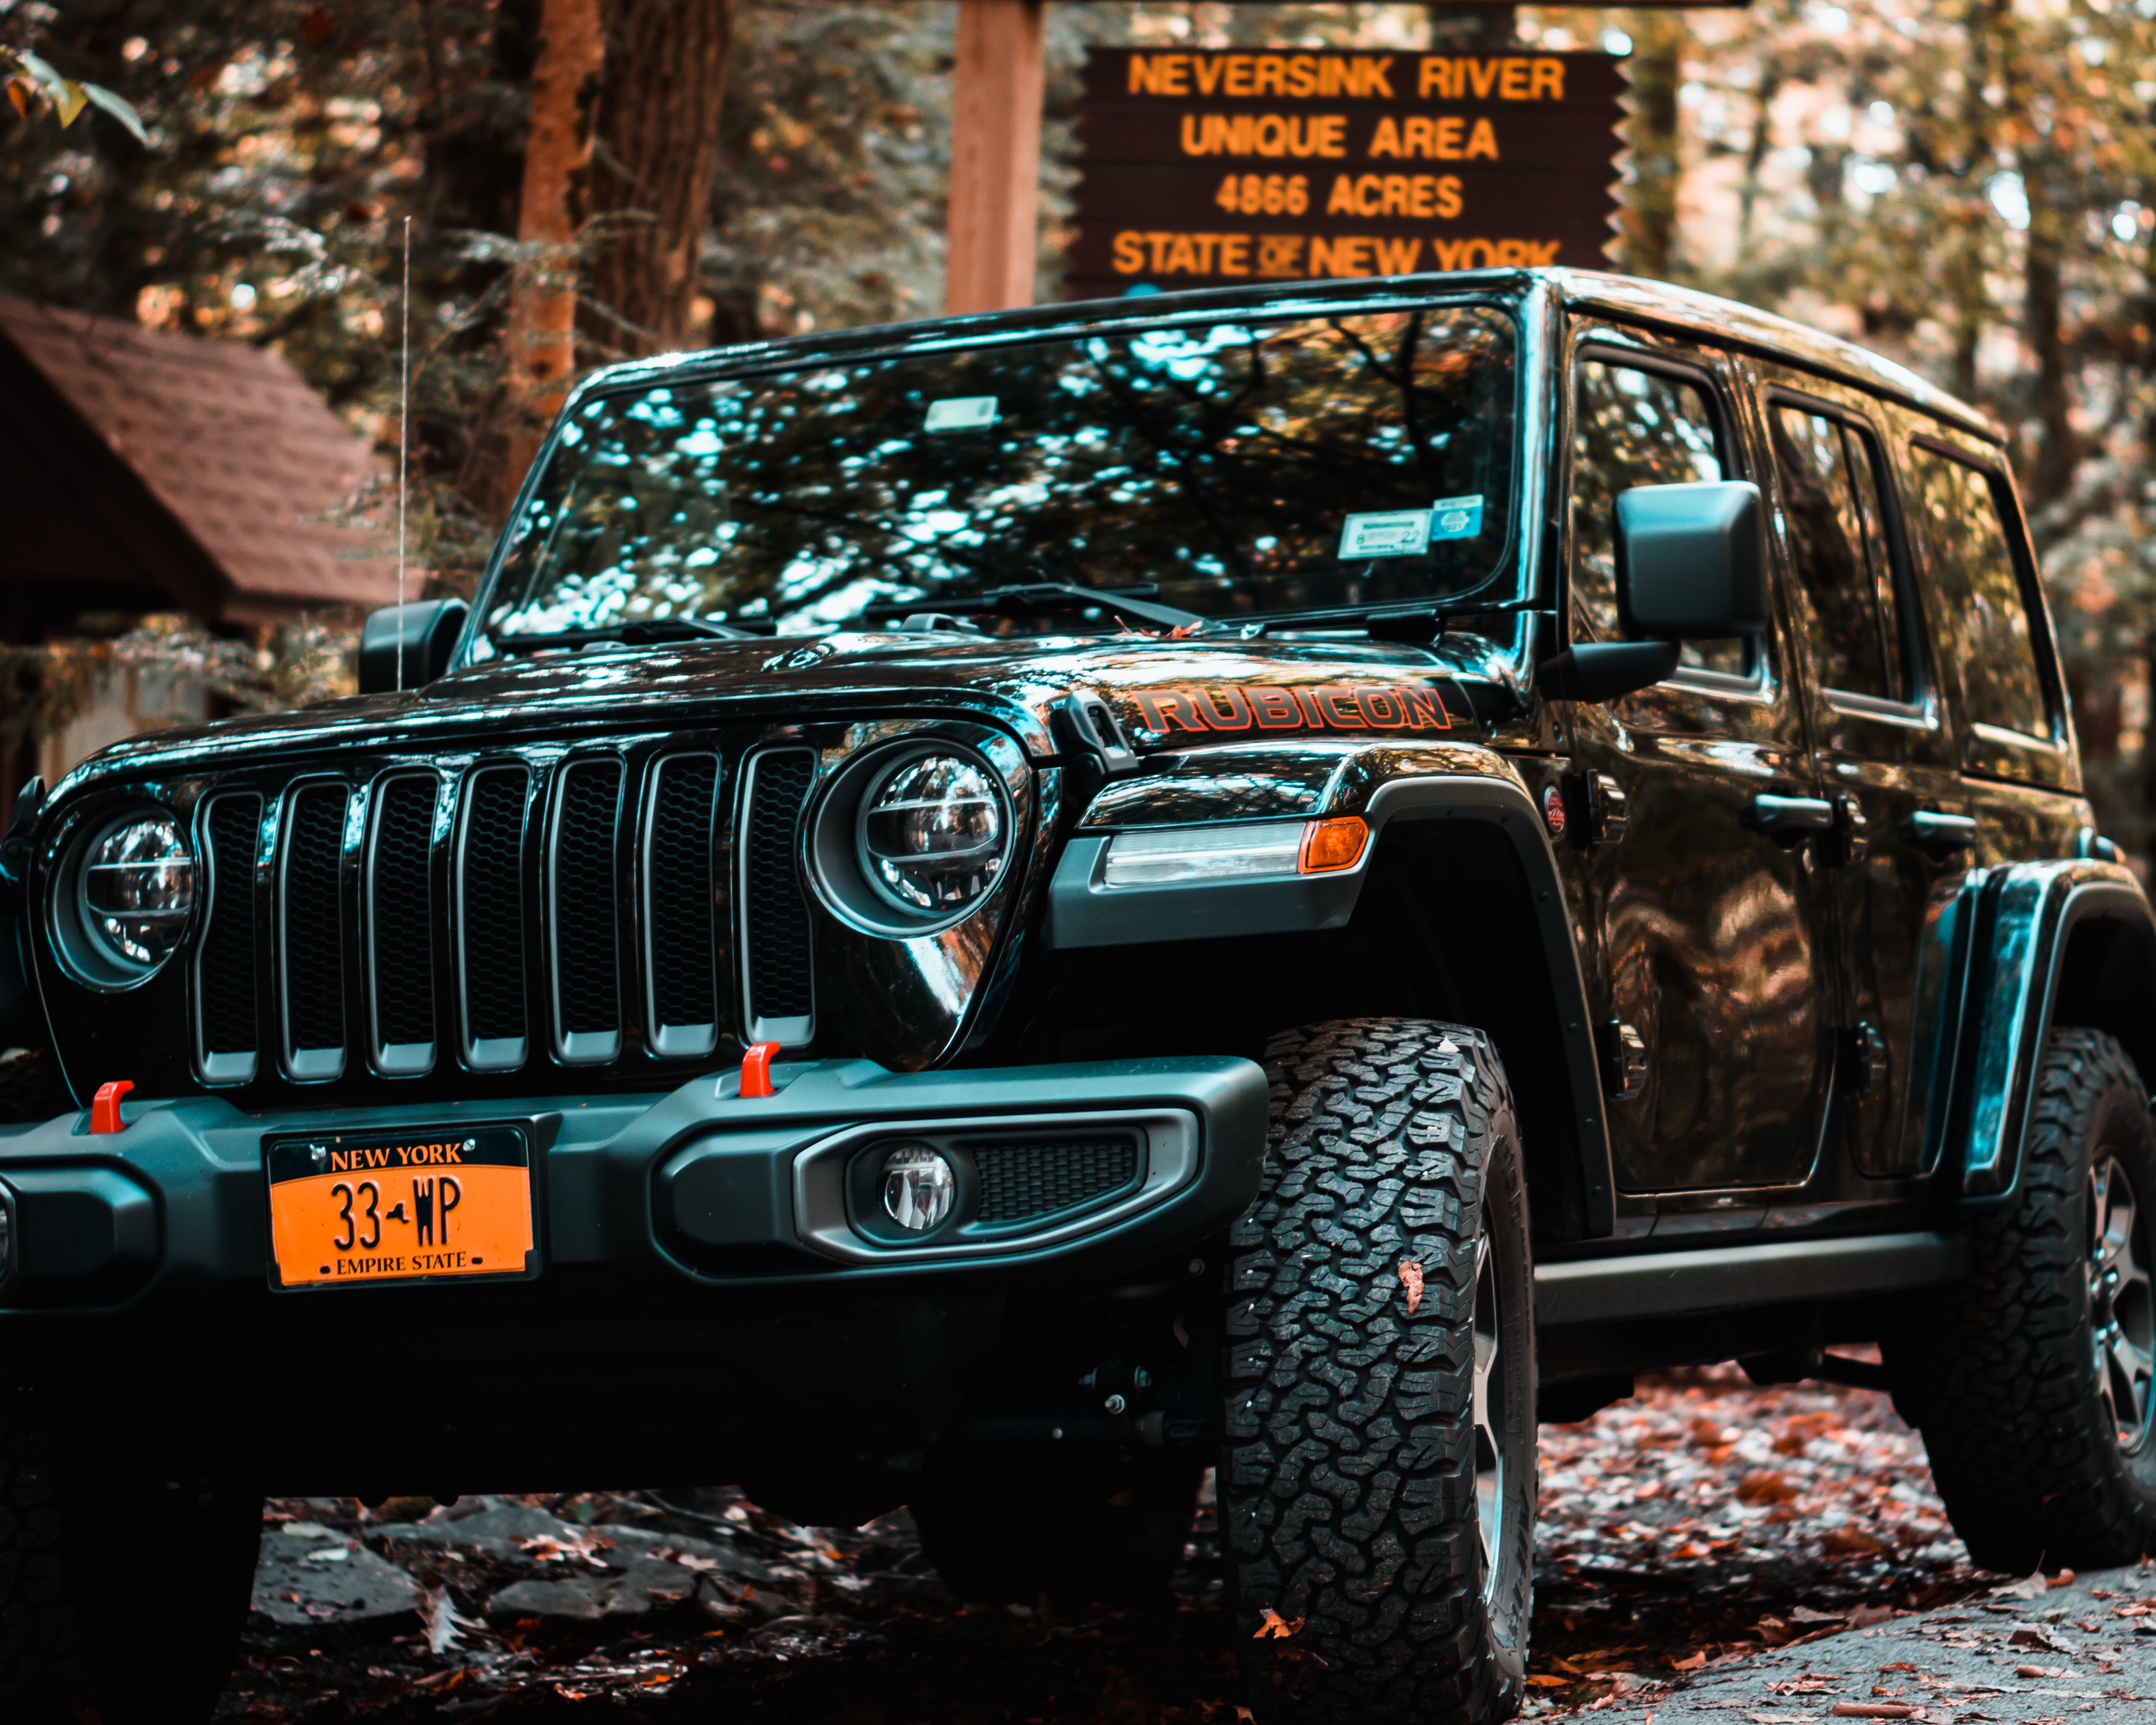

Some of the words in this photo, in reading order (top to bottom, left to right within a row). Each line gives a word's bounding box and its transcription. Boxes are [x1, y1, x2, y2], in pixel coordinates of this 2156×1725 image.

[1128, 54, 1394, 98] NEVERSINK
[1418, 57, 1565, 100] RIVER
[1181, 114, 1347, 158] UNIQUE
[1368, 116, 1499, 160] AREA
[1215, 174, 1309, 216] 4866
[1326, 174, 1463, 219] ACRES
[1113, 230, 1251, 276] STATE
[1257, 236, 1304, 276] OF
[1309, 236, 1422, 278] NEW
[1433, 238, 1561, 271] YORK
[1129, 685, 1451, 733] RUBICON
[331, 1148, 391, 1172] NEW
[396, 1143, 462, 1165] YORK
[337, 1256, 406, 1275] EMPIRE
[412, 1251, 467, 1270] STATE
